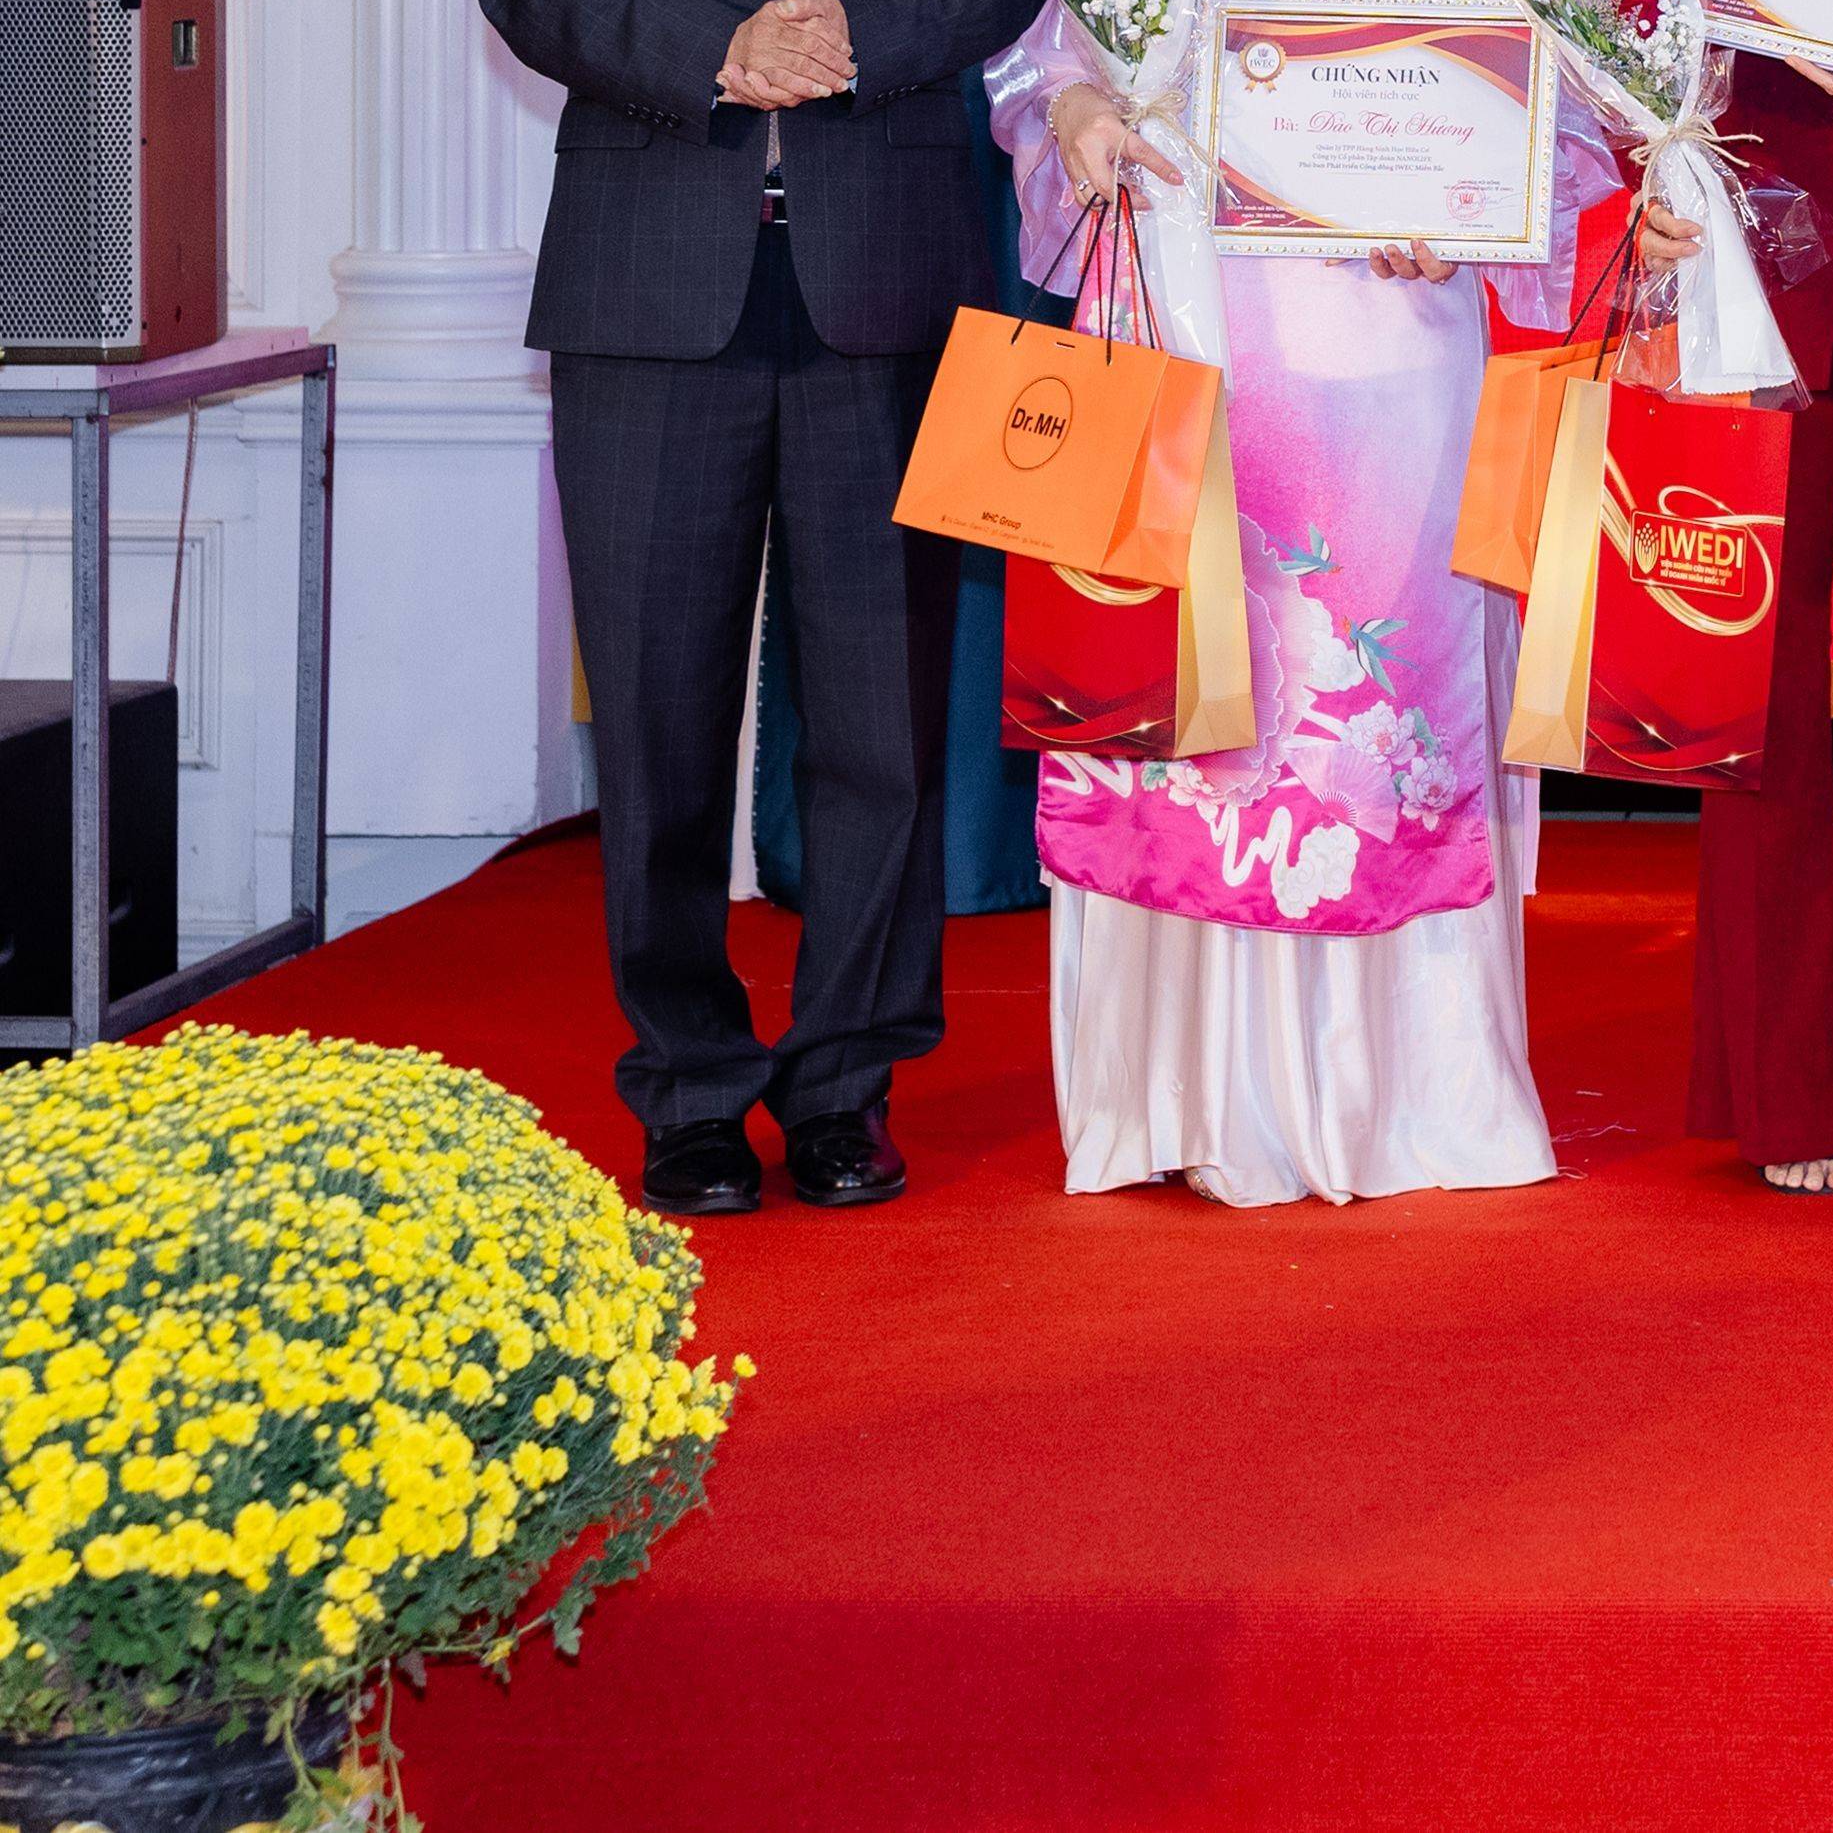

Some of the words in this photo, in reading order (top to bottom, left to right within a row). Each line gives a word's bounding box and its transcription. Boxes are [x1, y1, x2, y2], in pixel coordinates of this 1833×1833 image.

[1249, 59, 1276, 68] IWEC
[1311, 63, 1381, 84] CHỨNG
[1386, 66, 1441, 88] NHẬN
[1332, 89, 1353, 100] Hội
[1355, 89, 1377, 100] viên
[1379, 90, 1399, 101] tích
[1358, 109, 1400, 138] Thị
[1404, 112, 1476, 146] Hương
[1011, 407, 1067, 440] Dr.MH
[981, 511, 998, 524] MHC
[999, 516, 1022, 530] Group
[1659, 524, 1744, 569] IWEDI
